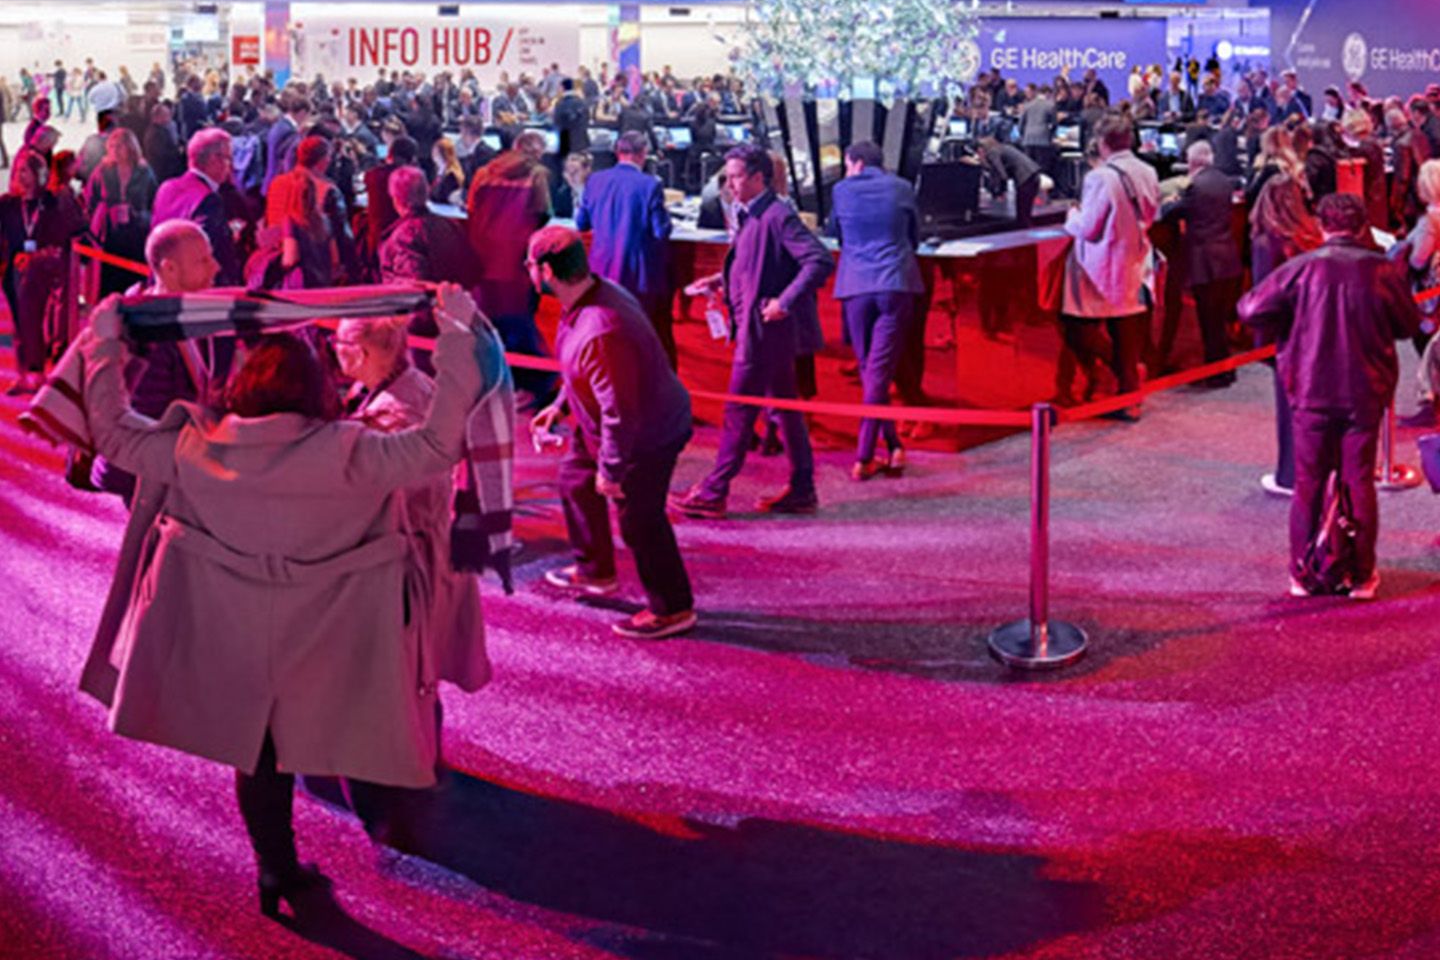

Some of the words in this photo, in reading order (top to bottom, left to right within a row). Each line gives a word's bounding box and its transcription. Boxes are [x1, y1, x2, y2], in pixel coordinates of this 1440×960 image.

[349, 27, 419, 66] INFO
[990, 47, 1018, 70] GE
[1021, 46, 1126, 70] HealthCare
[1370, 48, 1388, 70] GE
